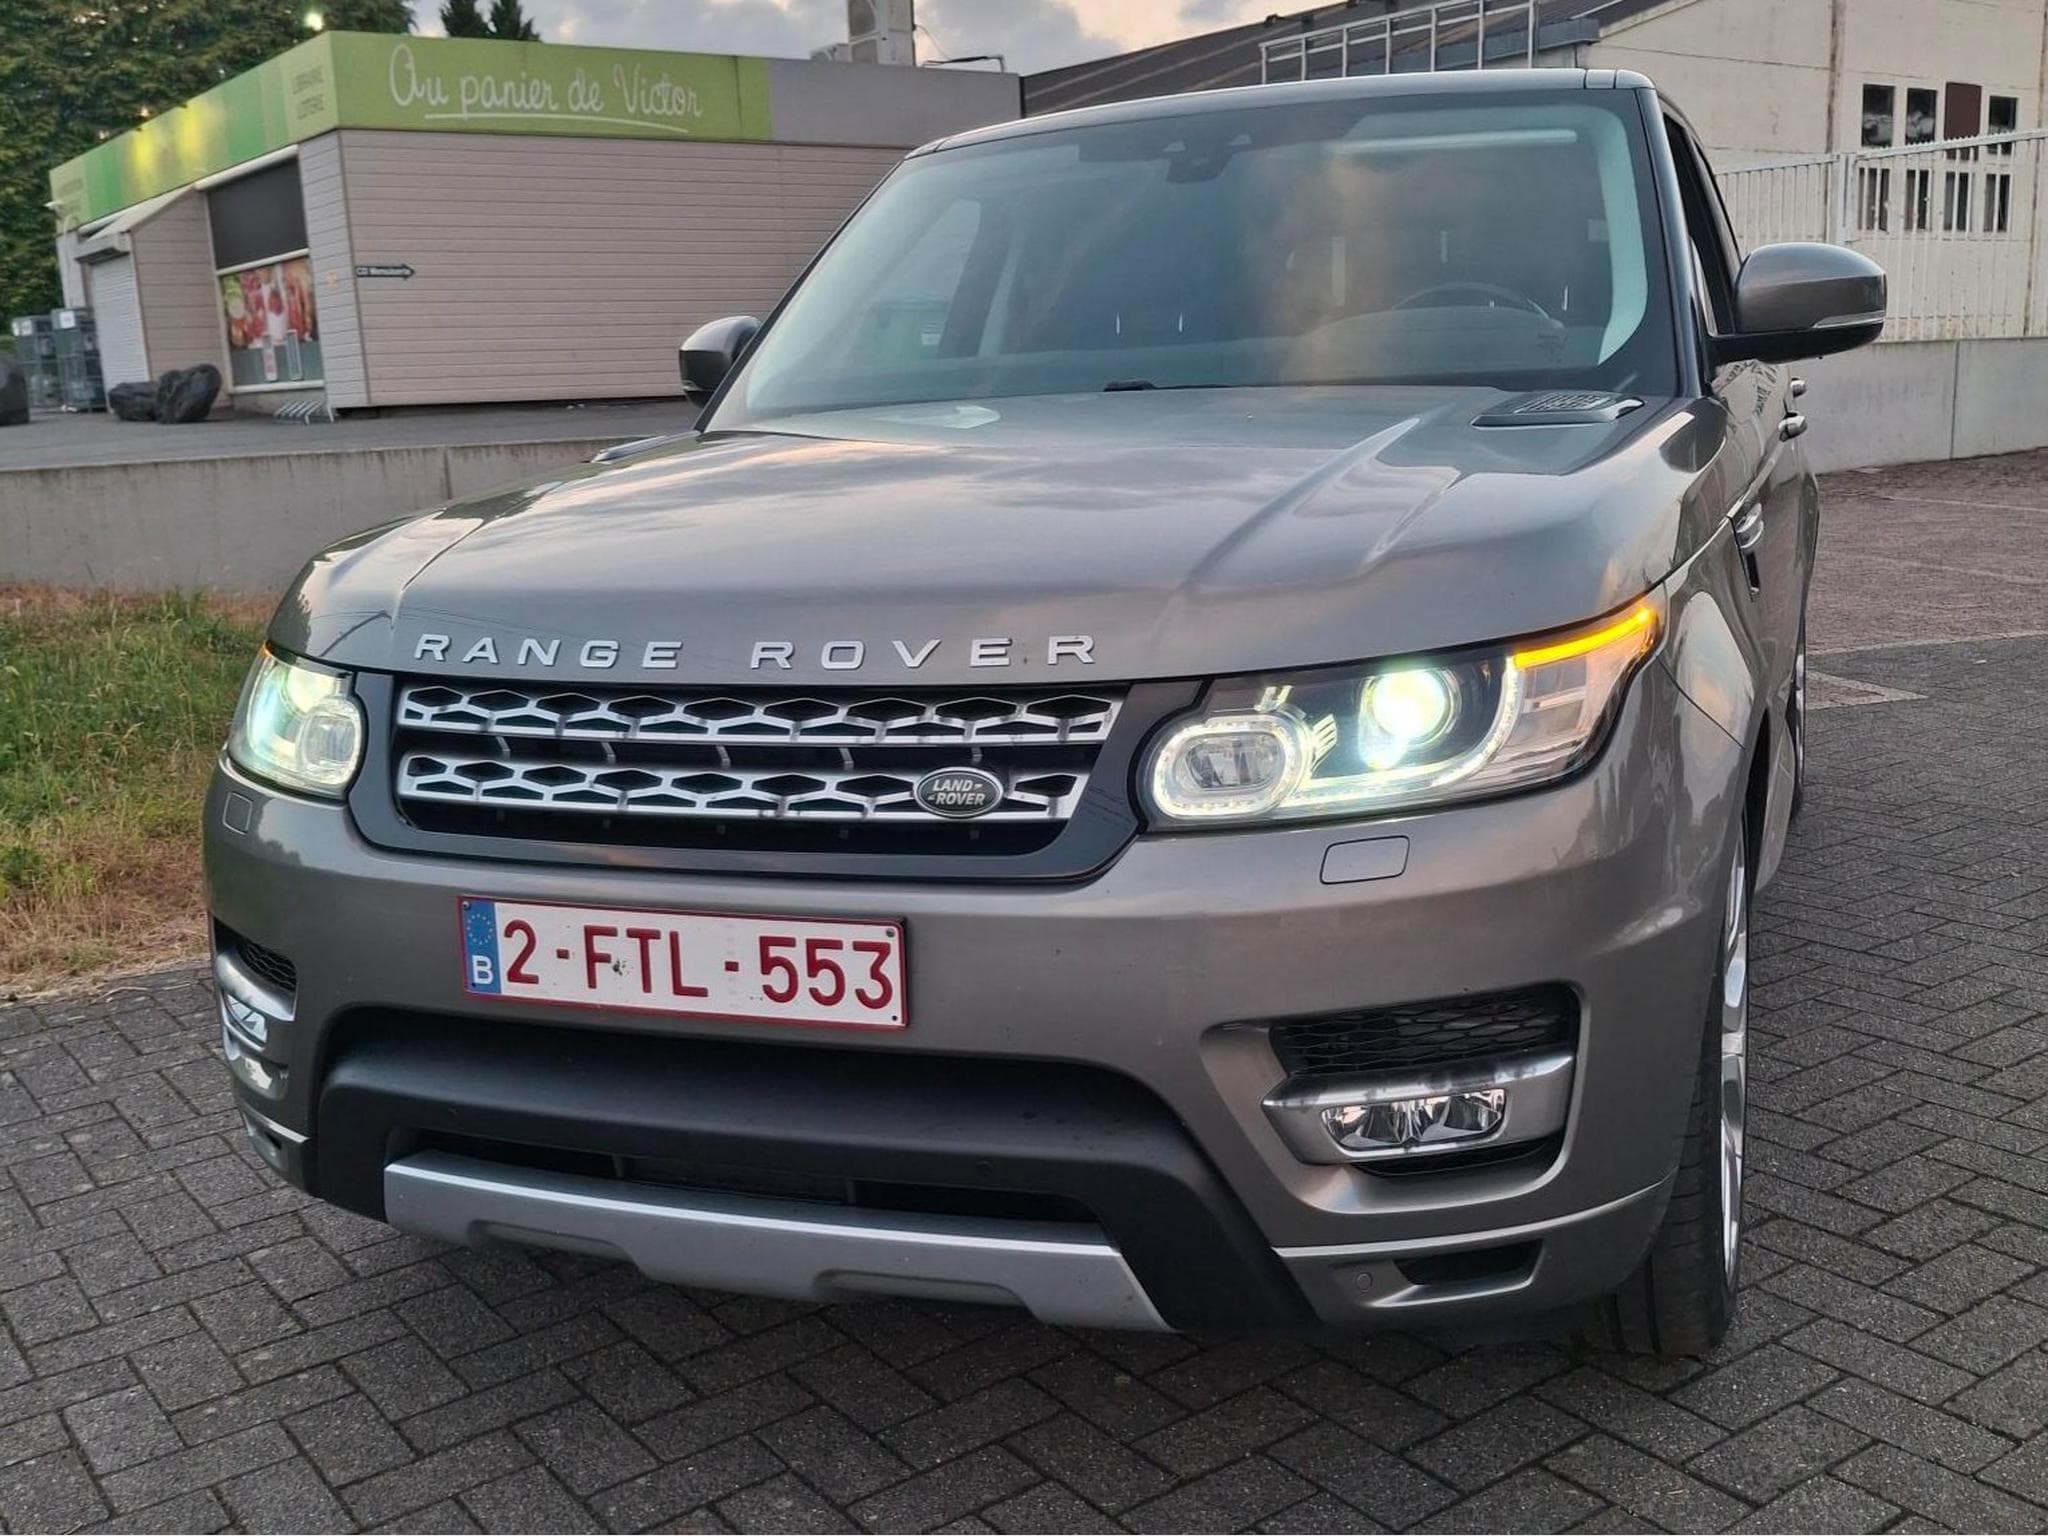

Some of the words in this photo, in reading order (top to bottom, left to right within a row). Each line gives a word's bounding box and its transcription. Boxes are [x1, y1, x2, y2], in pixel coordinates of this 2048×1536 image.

[389, 43, 449, 107] Au
[460, 71, 559, 120] panier
[568, 69, 604, 113] de
[613, 62, 703, 118] Victor
[413, 633, 683, 669] RANGE
[751, 634, 1096, 670] ROVER
[933, 779, 974, 792] LAND
[935, 792, 986, 805] ROVER
[472, 954, 494, 985] B
[504, 918, 893, 1010] 2-FTL-553
